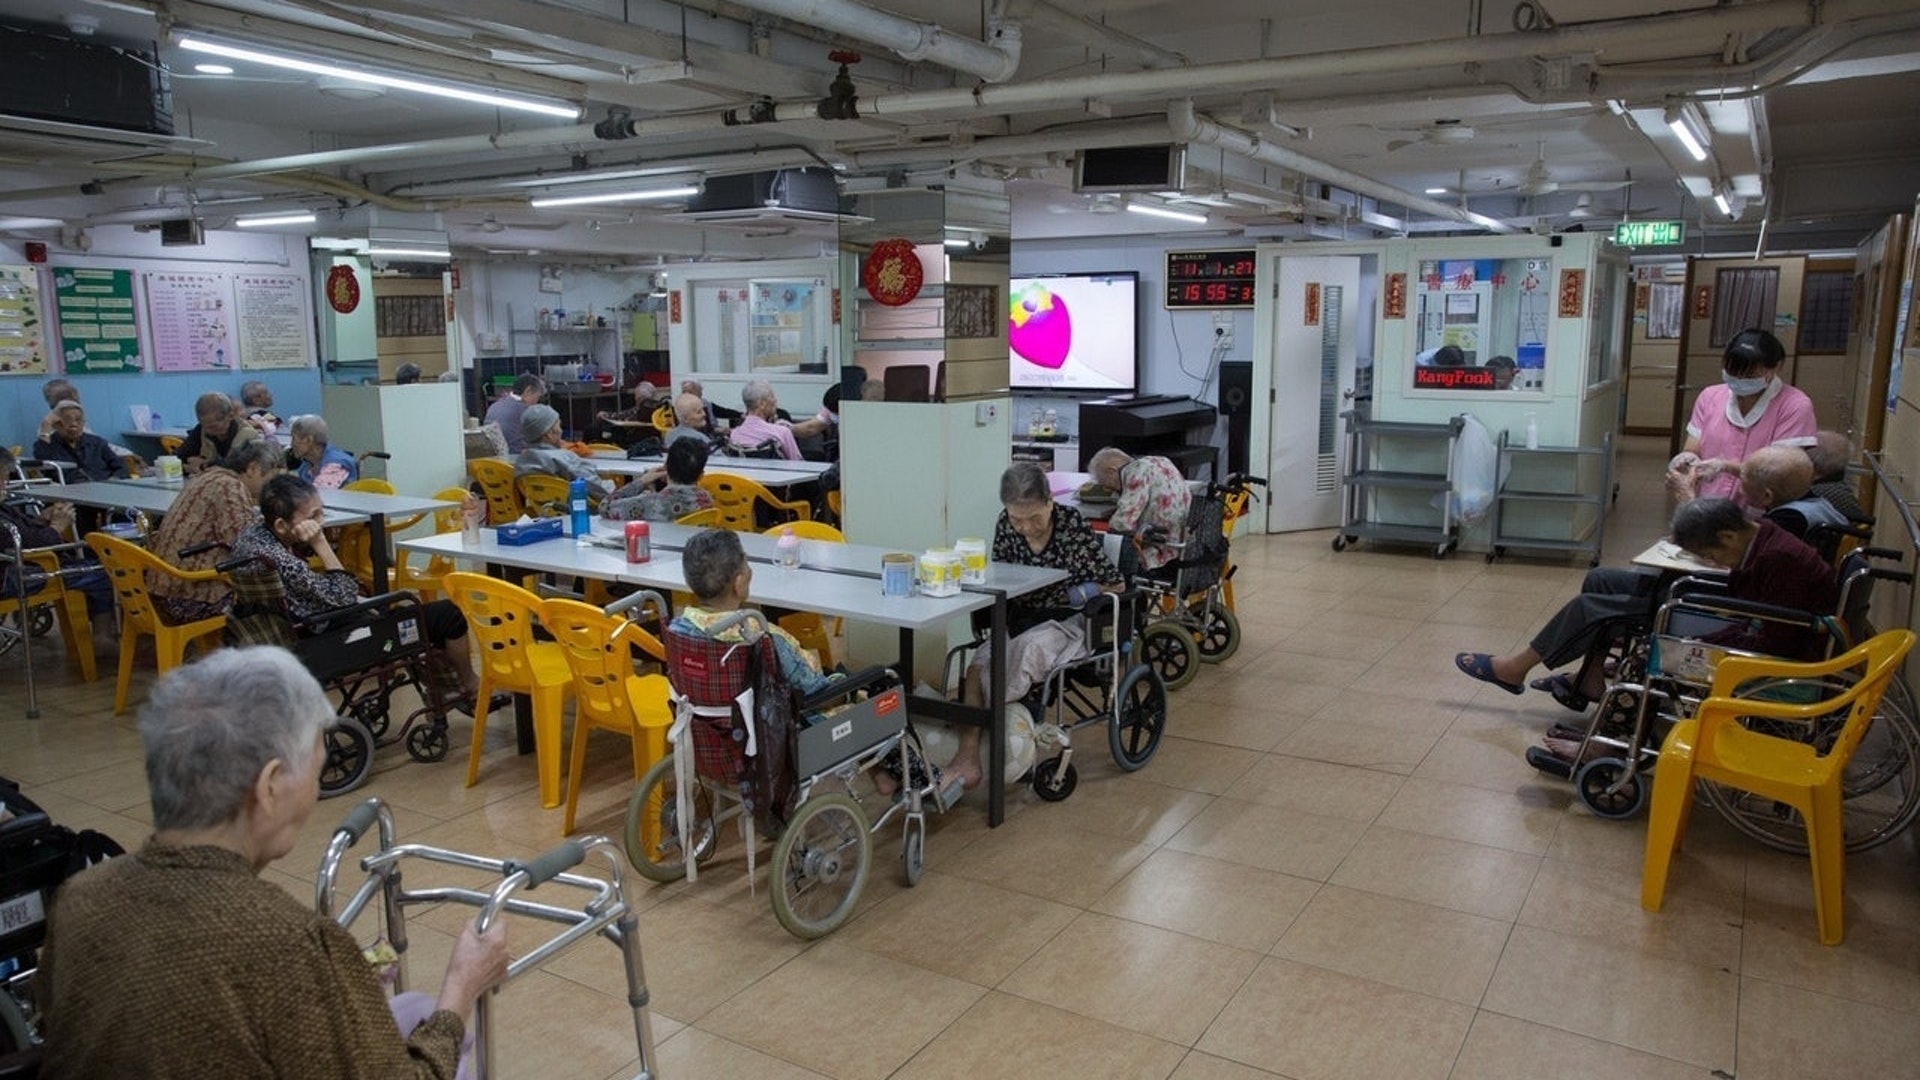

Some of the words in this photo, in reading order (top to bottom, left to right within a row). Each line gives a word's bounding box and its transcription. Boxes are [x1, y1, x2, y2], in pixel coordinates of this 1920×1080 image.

[1617, 223, 1648, 245] EXIT
[1652, 223, 1683, 244] 出口
[1235, 261, 1253, 275] 27
[1426, 270, 1540, 292] 醫療中心
[1206, 284, 1227, 300] 55
[1417, 369, 1494, 387] KangFook
